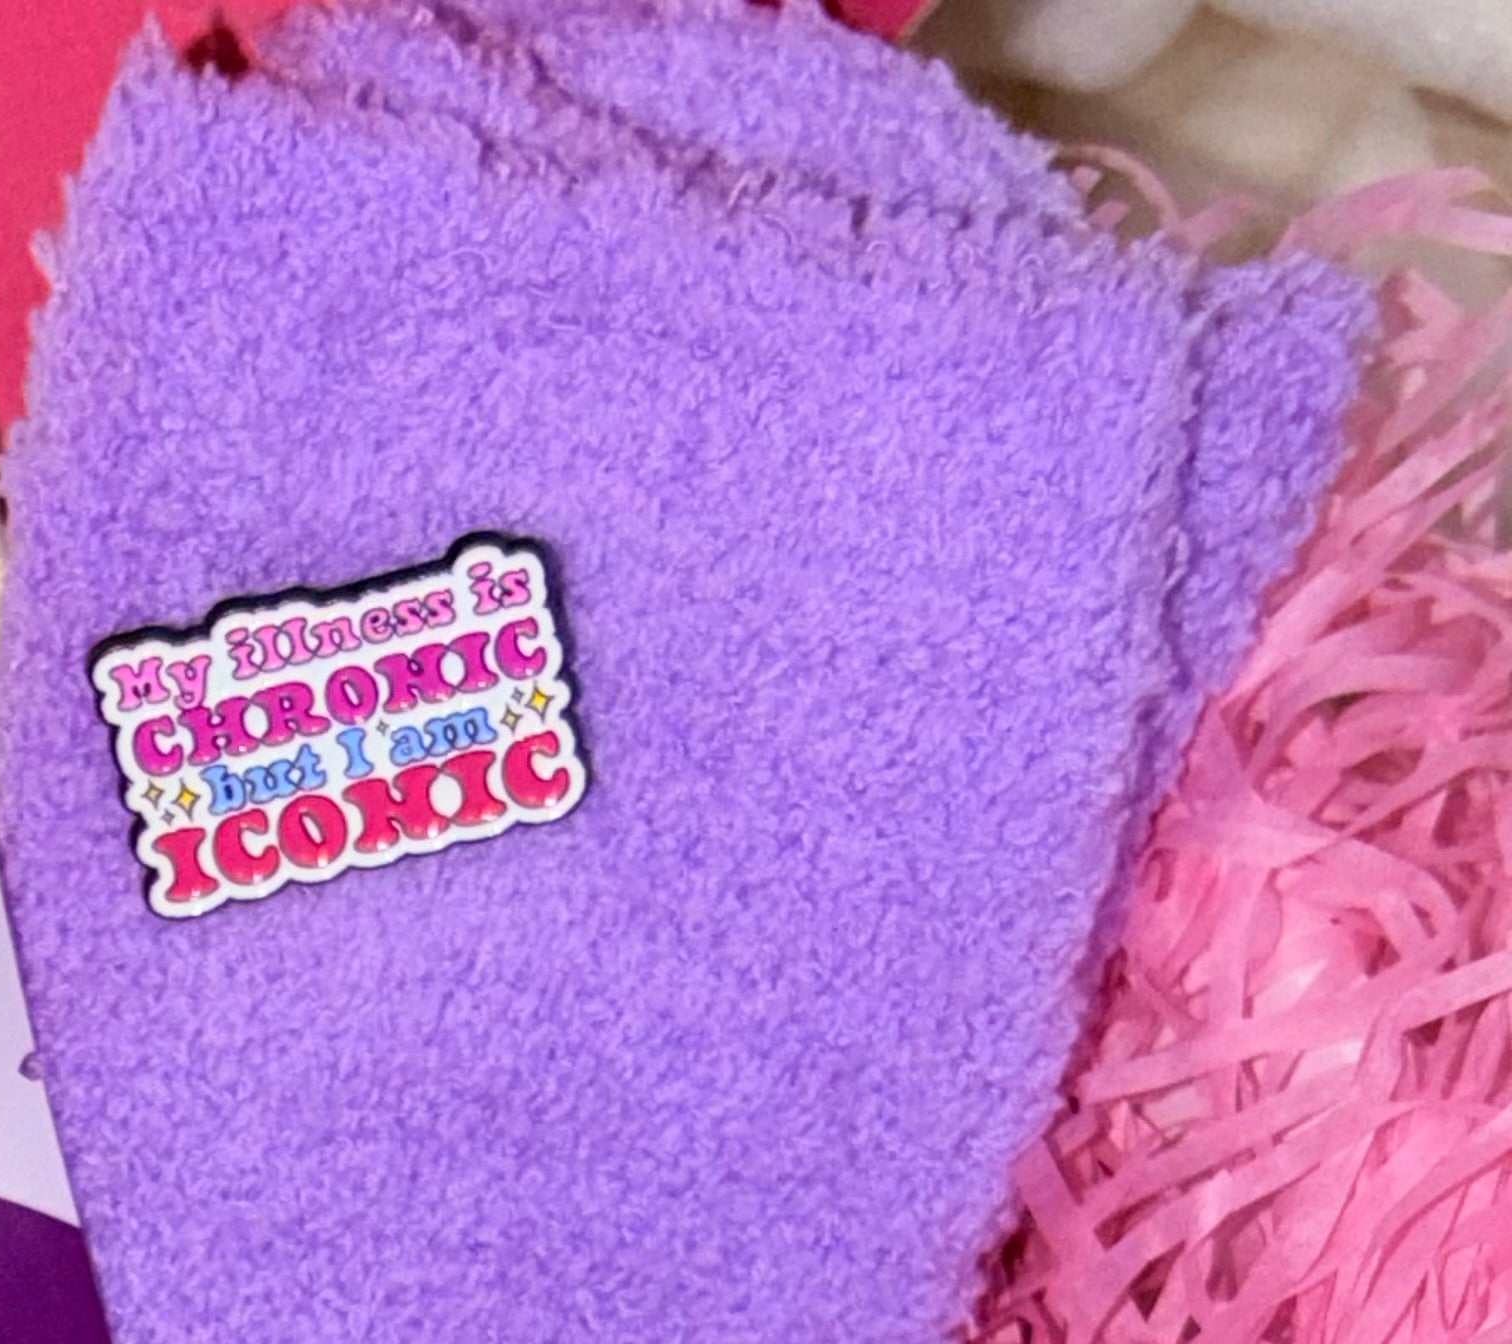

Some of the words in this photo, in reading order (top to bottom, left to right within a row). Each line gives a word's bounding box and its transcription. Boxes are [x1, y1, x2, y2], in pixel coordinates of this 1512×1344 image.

[109, 653, 211, 710] My
[226, 588, 454, 680] illness
[468, 561, 531, 615] is
[132, 618, 547, 776] CHRONIC
[152, 730, 570, 903] ICONIC
[200, 744, 327, 815] but
[337, 727, 374, 779] I
[390, 706, 497, 766] am
